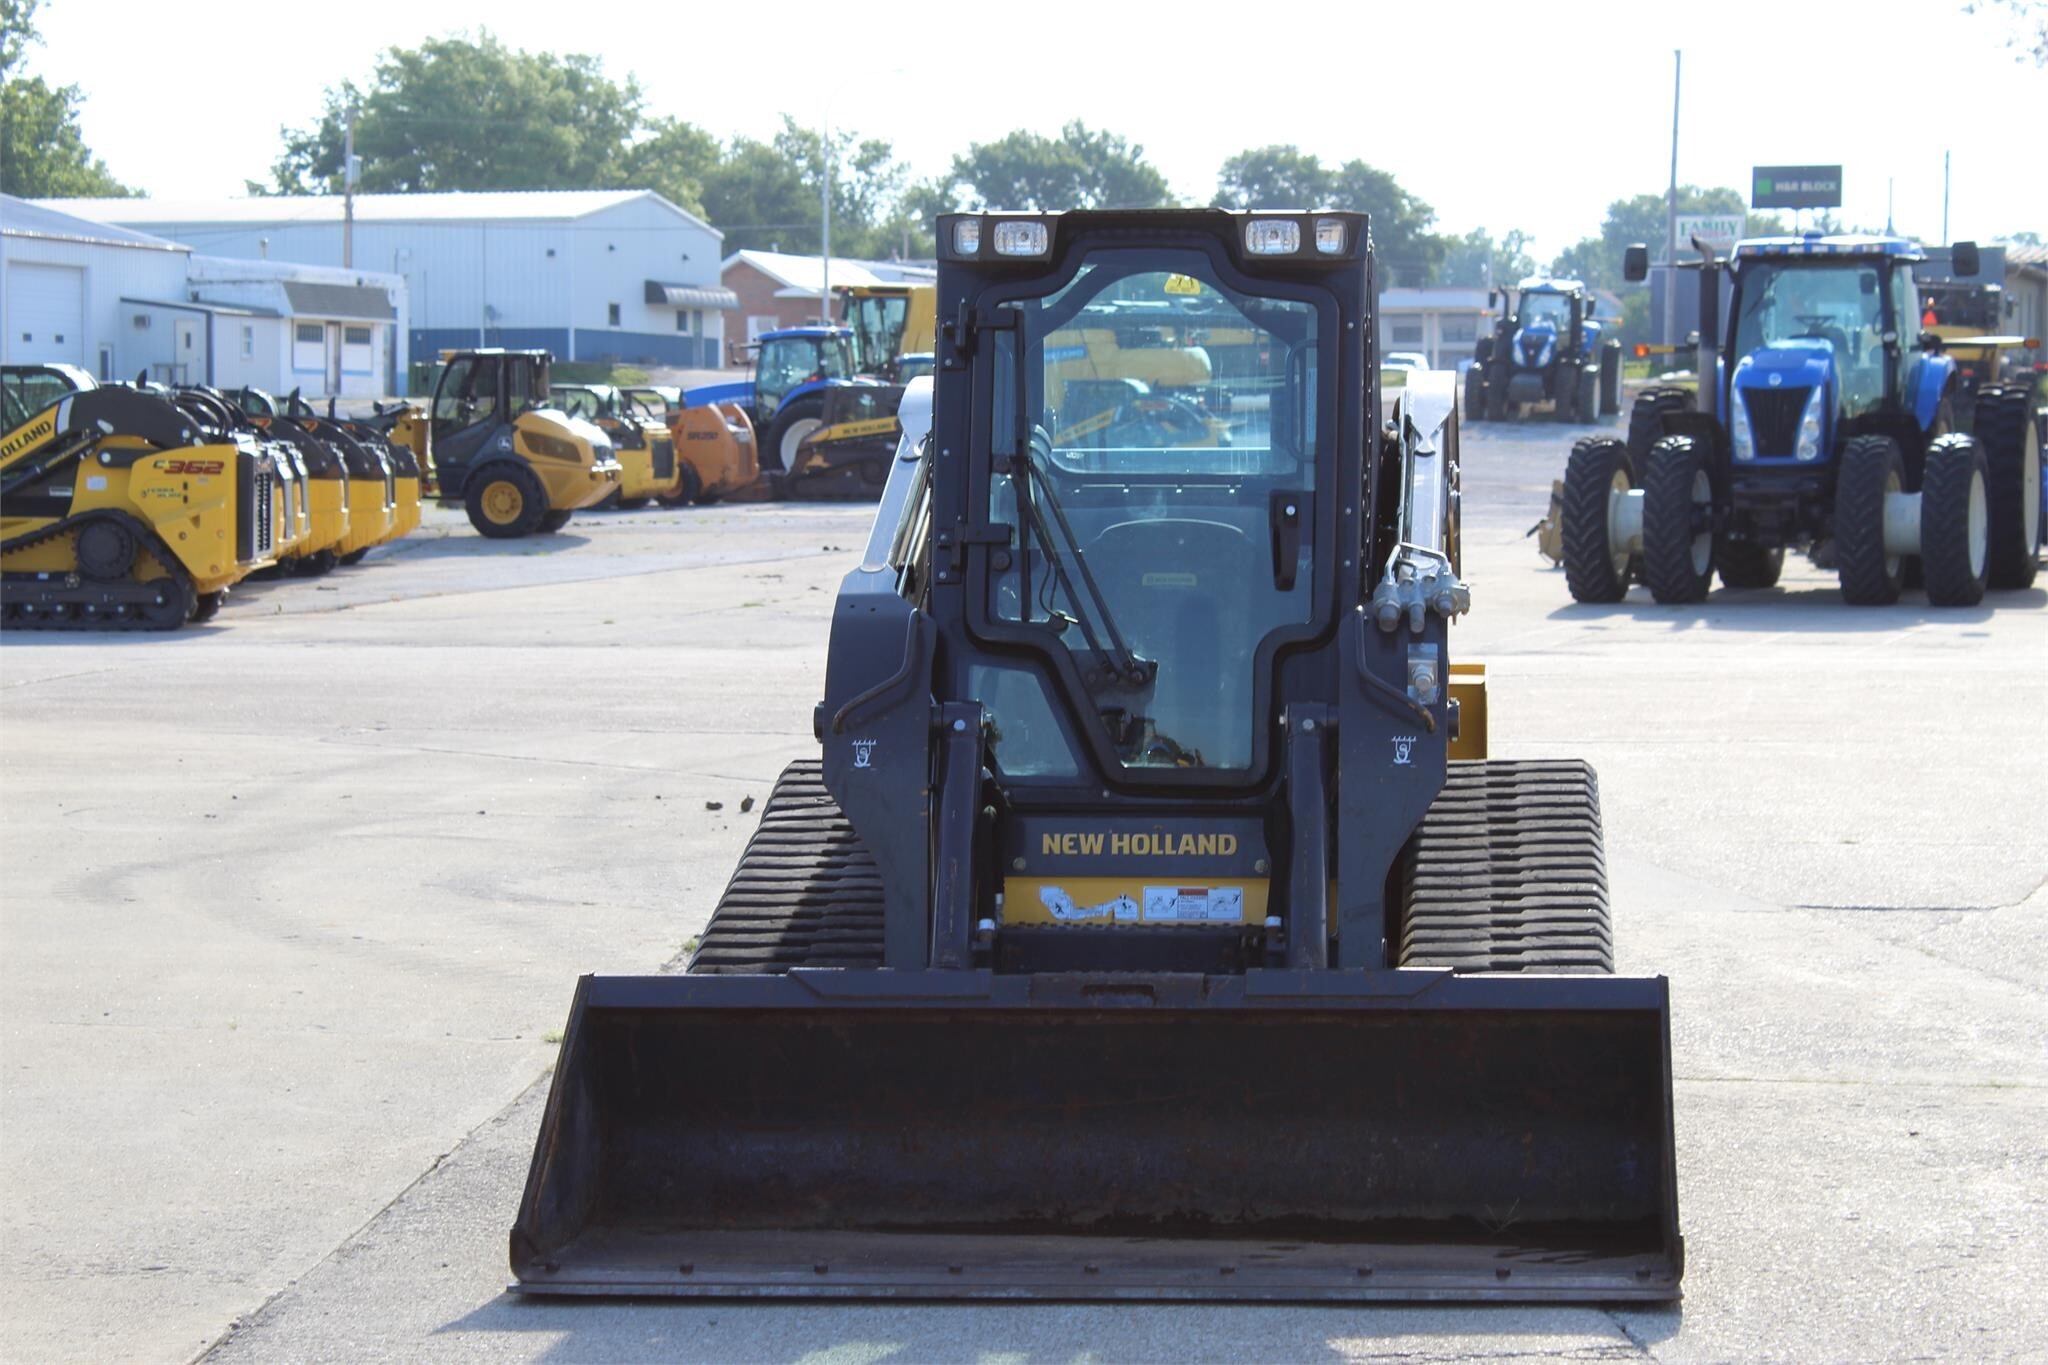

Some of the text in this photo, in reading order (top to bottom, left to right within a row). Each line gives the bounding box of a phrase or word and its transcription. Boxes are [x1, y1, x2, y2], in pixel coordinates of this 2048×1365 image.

[1801, 181, 1837, 192] BLOCK
[1681, 221, 1737, 236] FAMILY
[0, 421, 52, 460] OLLAND
[1042, 833, 1237, 856] NEW HOLLAND
